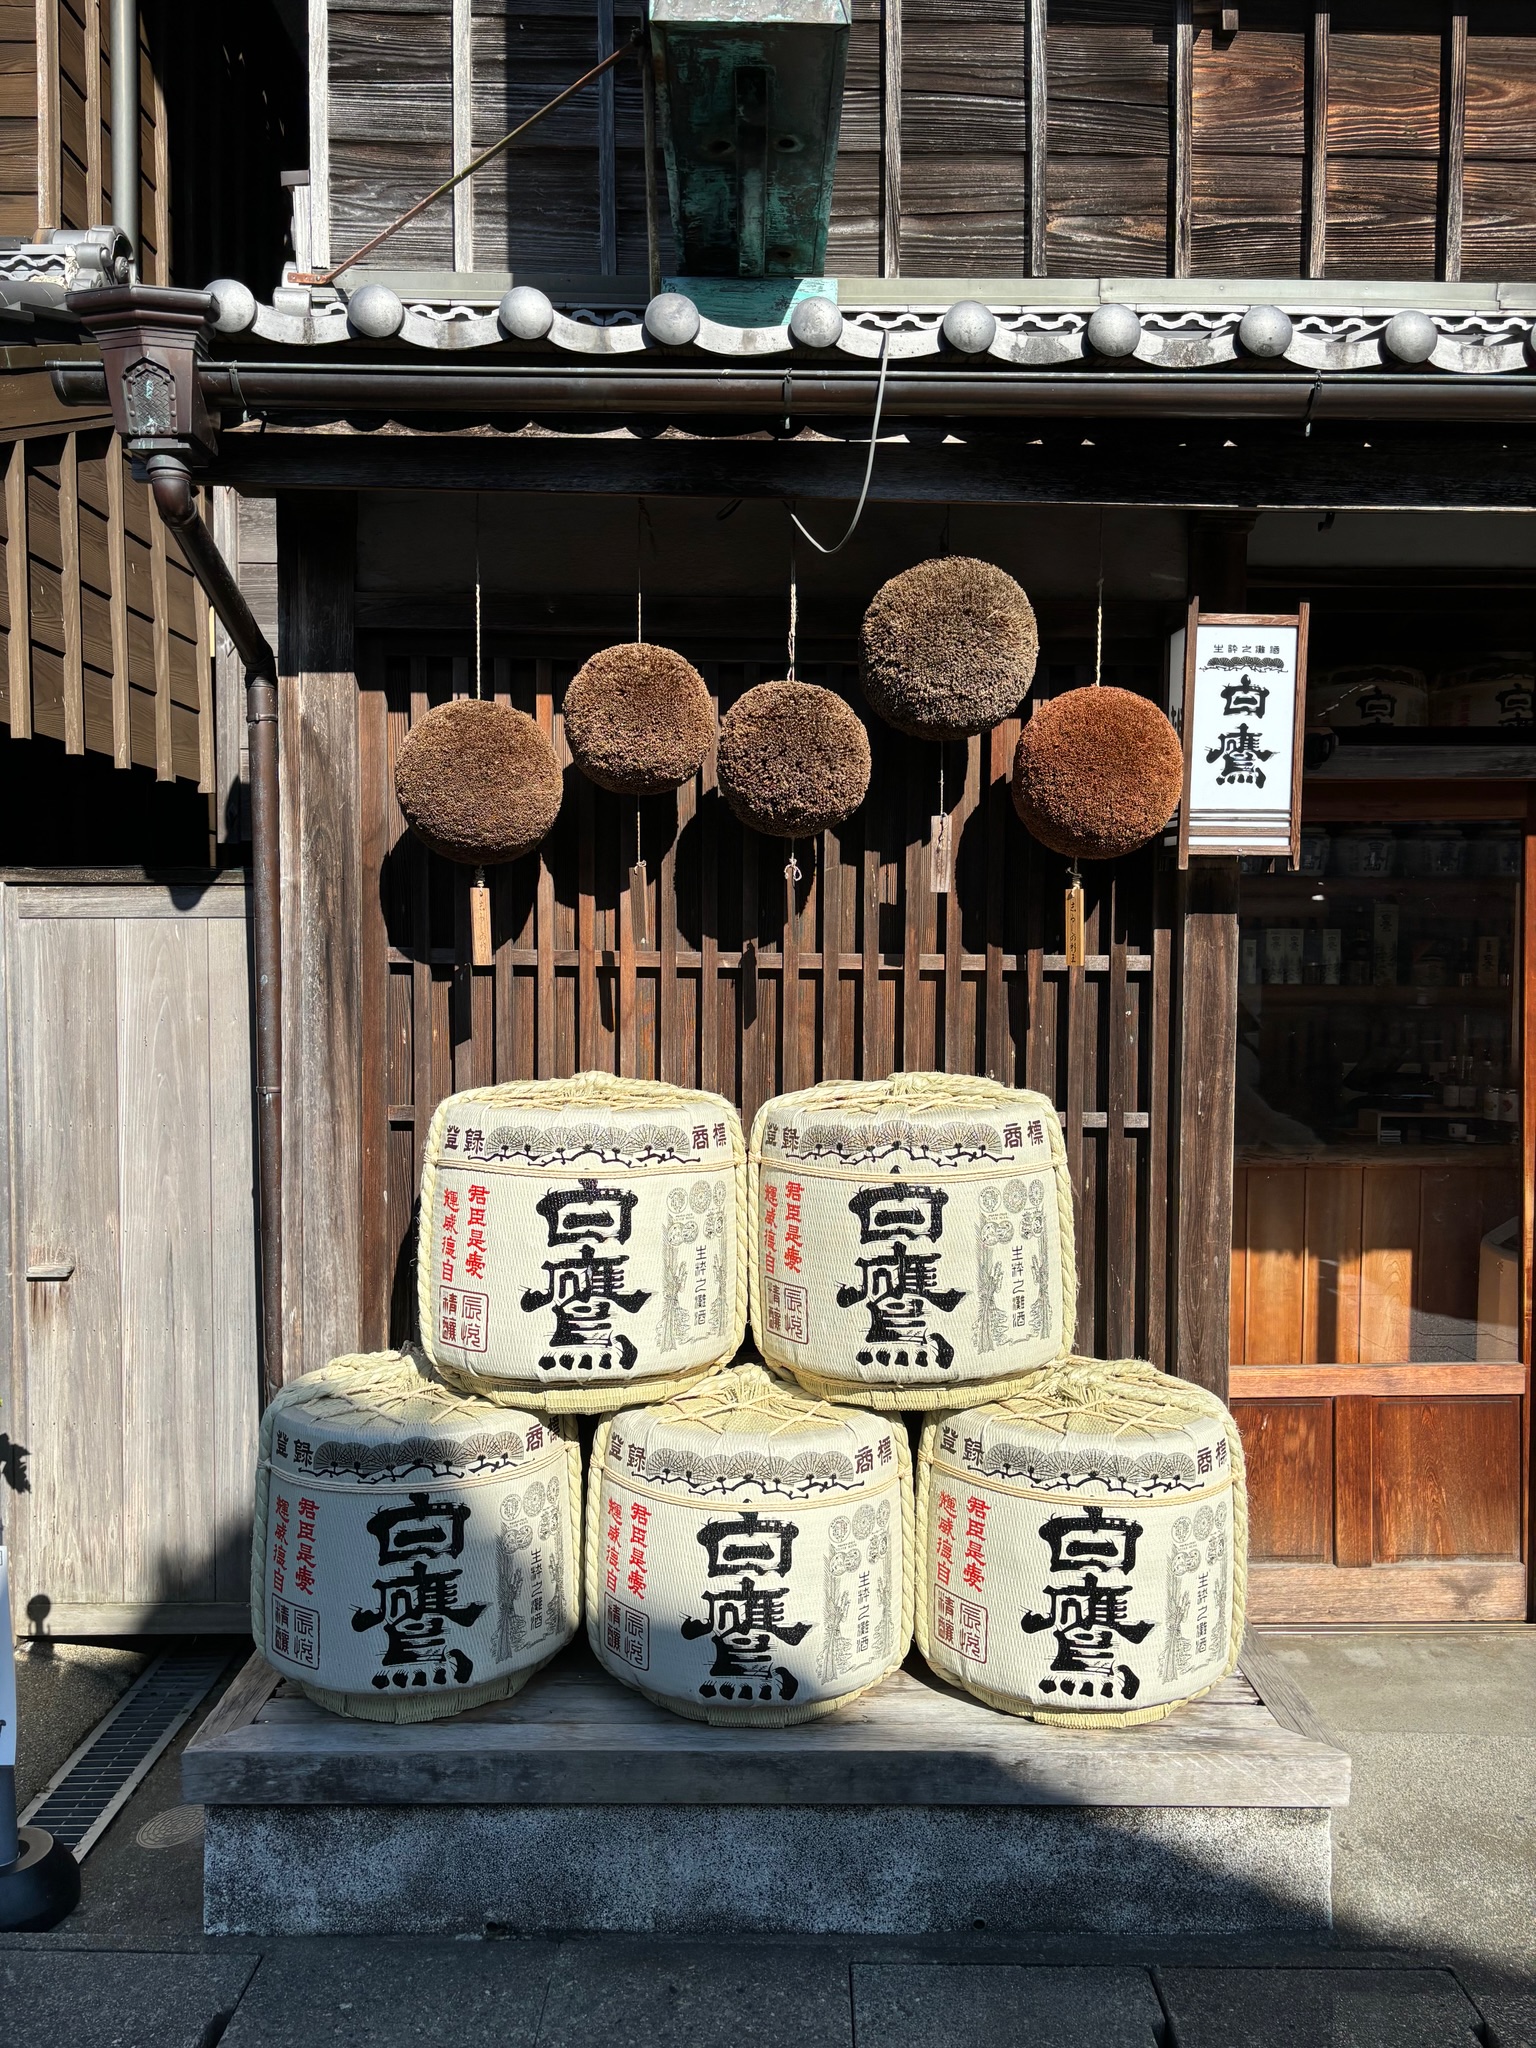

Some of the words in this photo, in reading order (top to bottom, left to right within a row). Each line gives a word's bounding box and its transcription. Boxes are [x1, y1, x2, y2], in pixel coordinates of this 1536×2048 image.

[1205, 673, 1280, 789] 白鷹
[1356, 686, 1397, 726] 白
[521, 1168, 655, 1371] 白鷹
[835, 1165, 970, 1369] 白鷹
[350, 1492, 492, 1689] 白鷹
[679, 1498, 818, 1700] 白鷹
[1020, 1498, 1157, 1700] 白鷹
